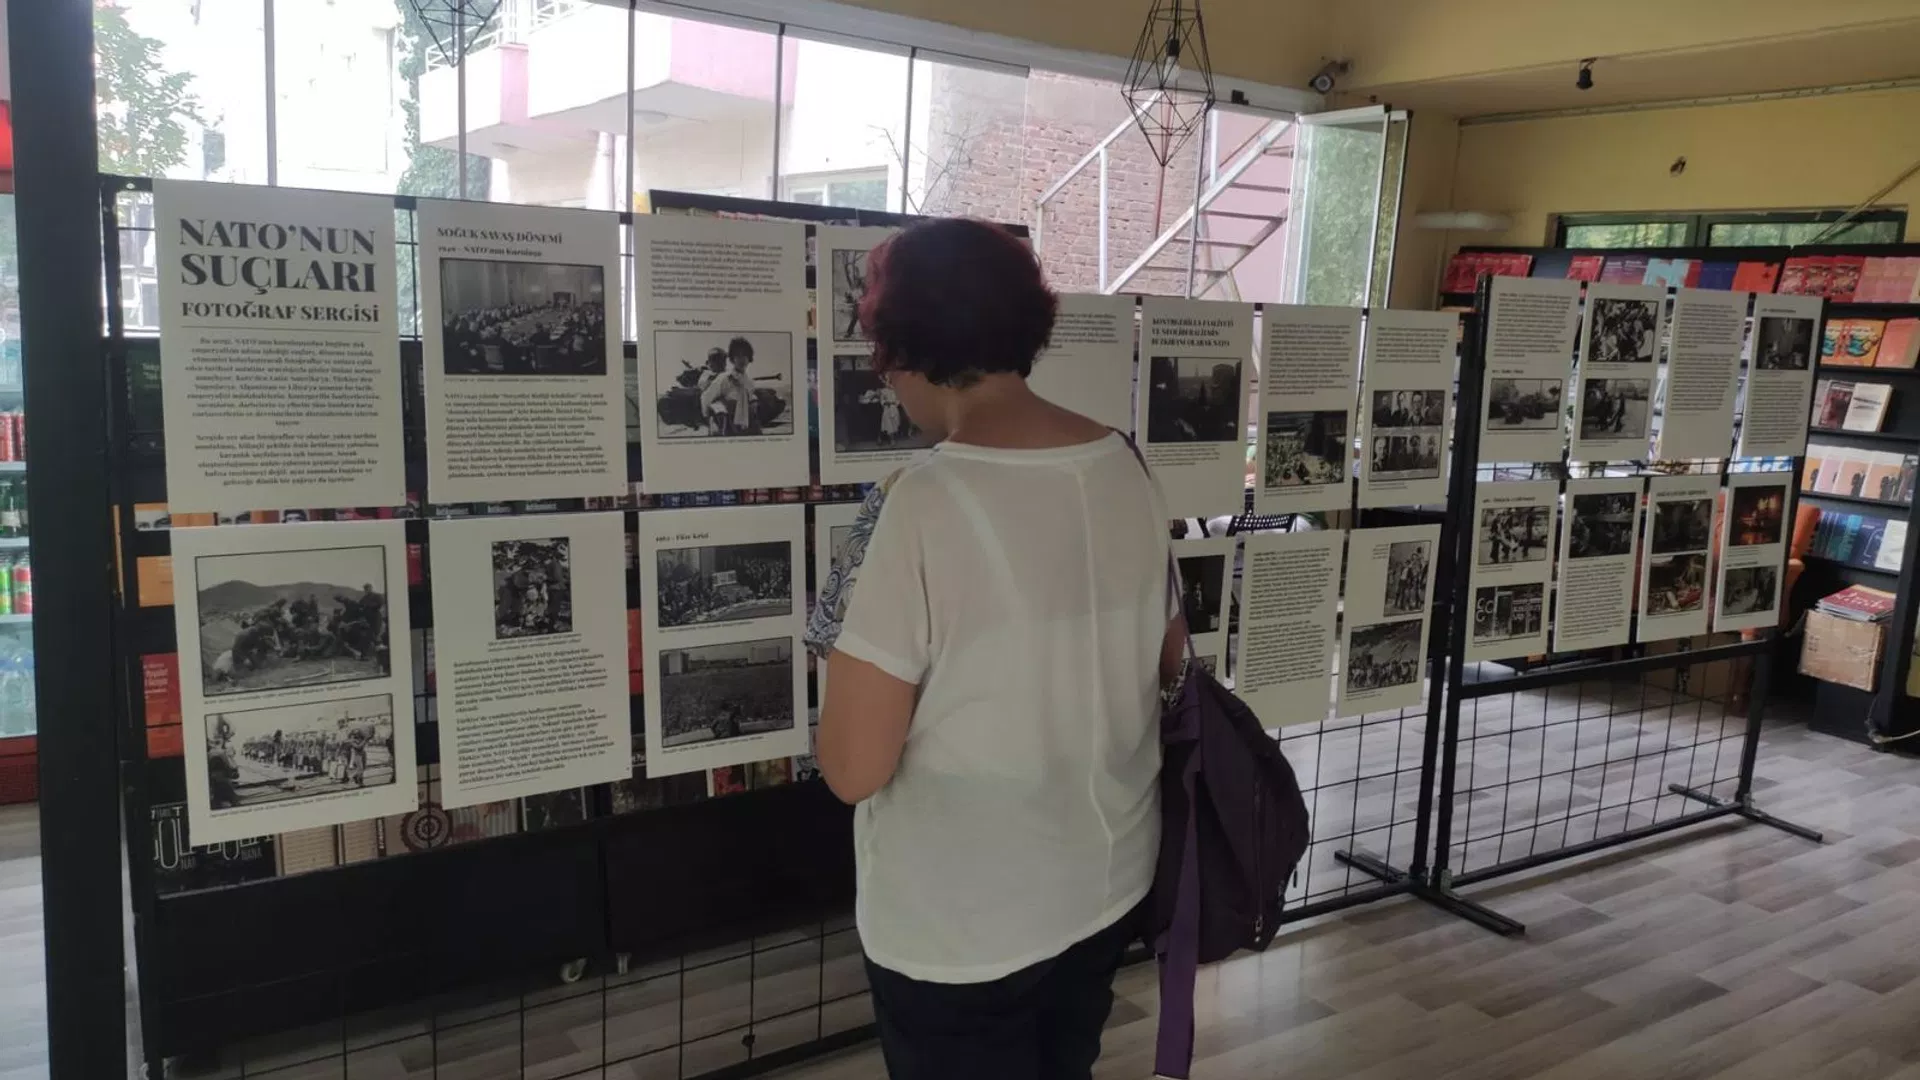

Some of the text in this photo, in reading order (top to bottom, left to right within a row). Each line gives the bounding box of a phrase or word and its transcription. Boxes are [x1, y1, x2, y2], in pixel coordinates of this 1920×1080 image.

[178, 217, 376, 256] NATO'NUN
[437, 226, 563, 244] SOĞUK SAVAŞ DÖNEMİ
[180, 252, 377, 295] SUÇLARI
[181, 300, 380, 323] FOTOĞRAF SERGİSİ
